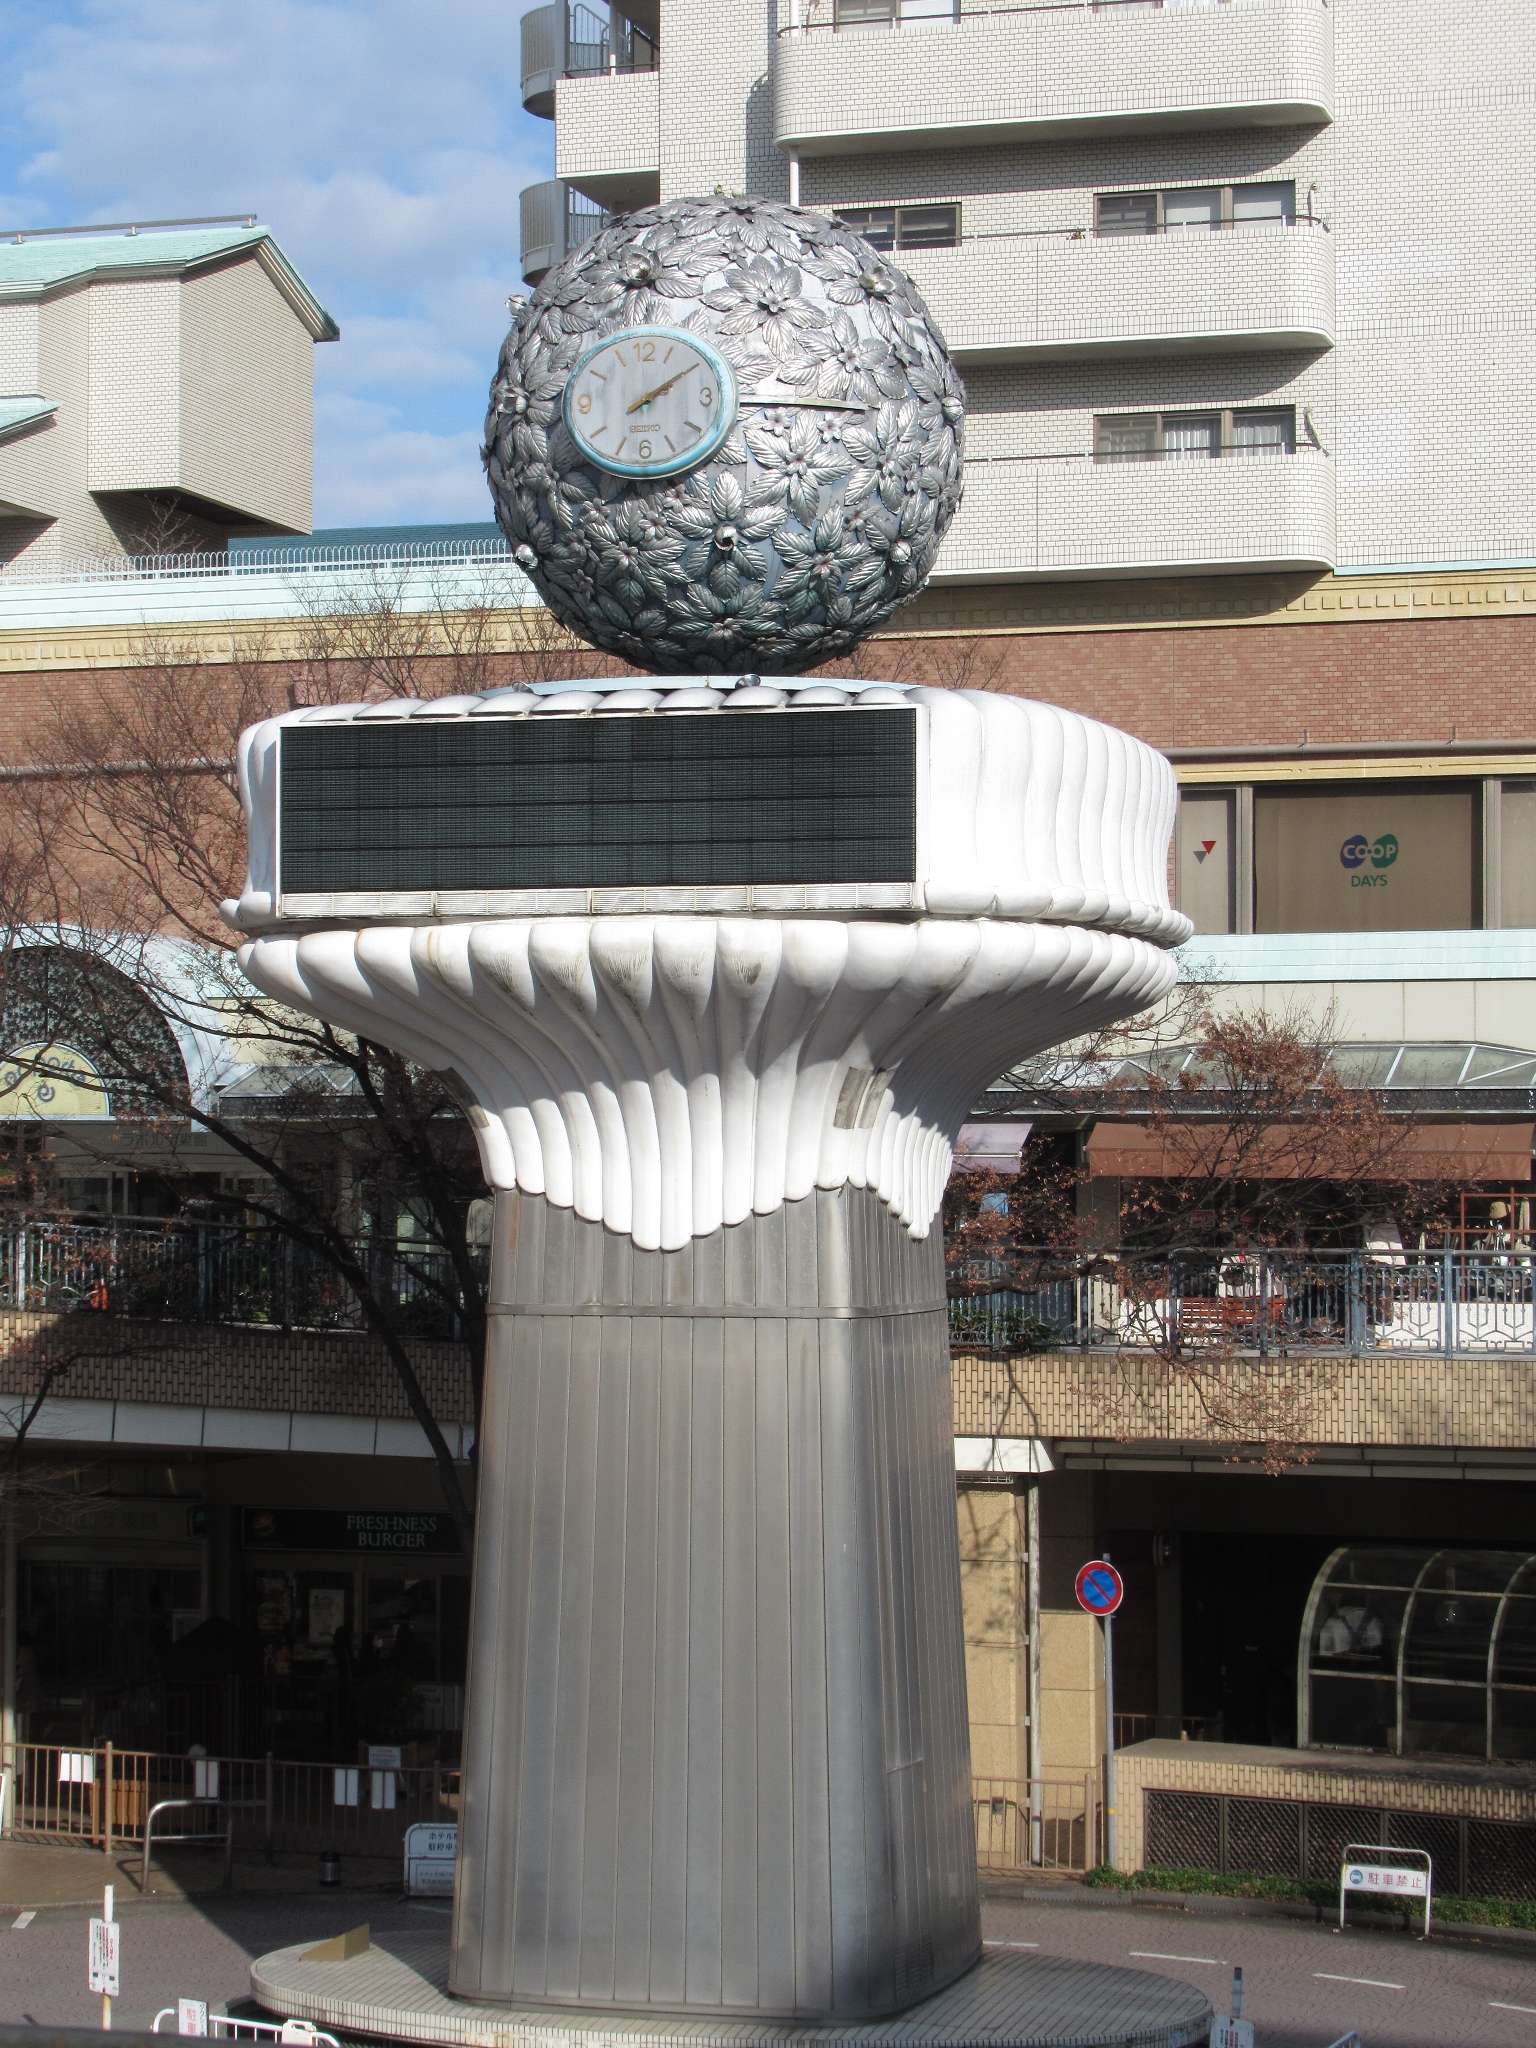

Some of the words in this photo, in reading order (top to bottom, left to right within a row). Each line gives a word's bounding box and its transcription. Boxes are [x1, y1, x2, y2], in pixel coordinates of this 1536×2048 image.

[633, 342, 656, 362] 12
[577, 394, 592, 414] 9
[699, 387, 713, 407] 3
[639, 439, 651, 459] 6
[1351, 874, 1388, 887] DAYS
[347, 1516, 437, 1532] FRESHNESS
[358, 1531, 426, 1548] BURGER
[1368, 1871, 1422, 1888] 駐車禁止
